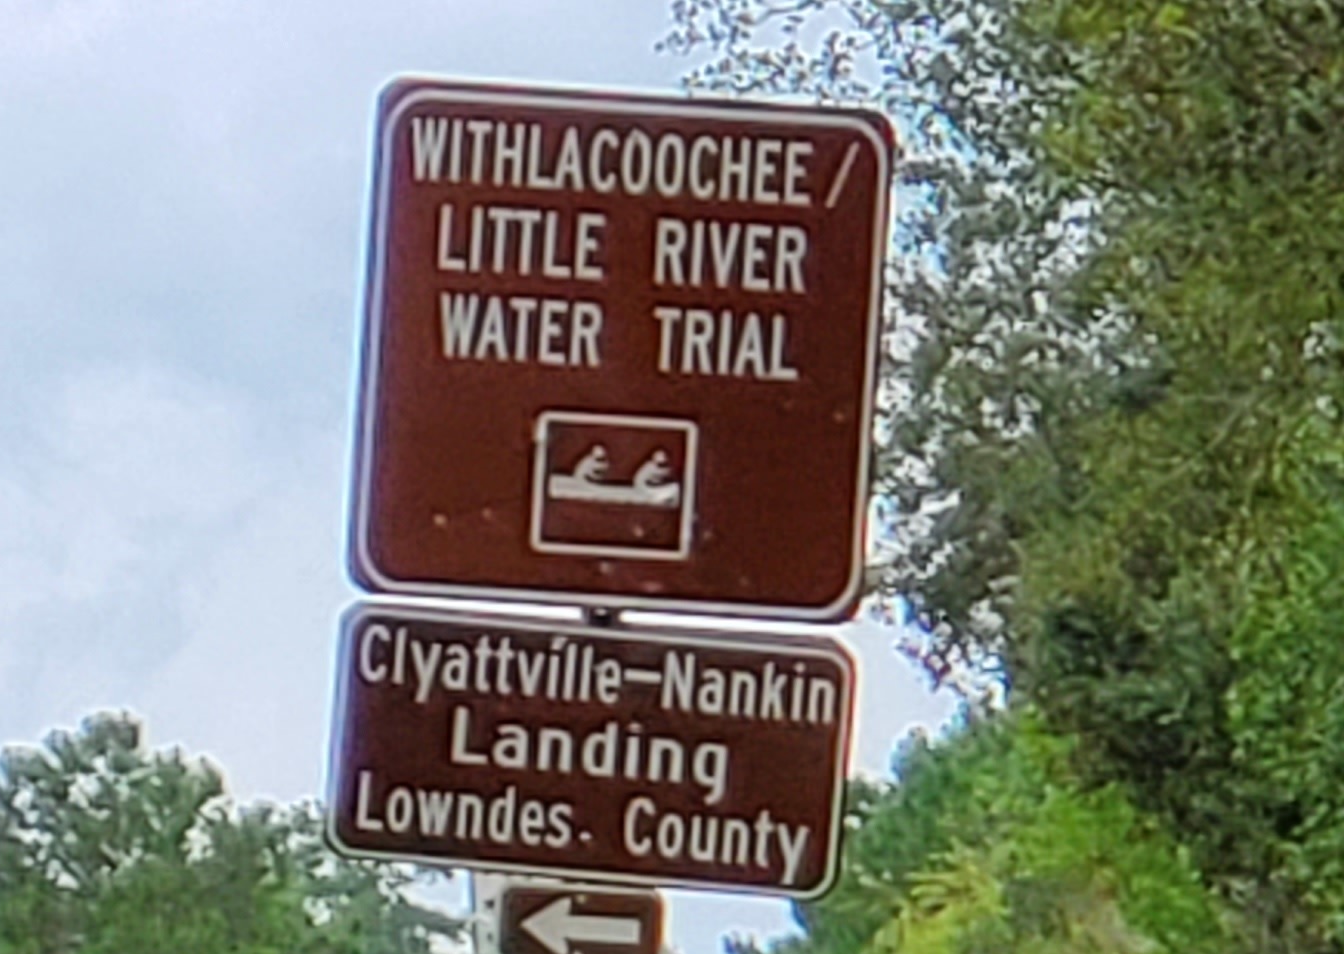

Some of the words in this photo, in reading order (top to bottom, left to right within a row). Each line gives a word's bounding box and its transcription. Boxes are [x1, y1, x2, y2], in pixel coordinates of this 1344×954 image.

[437, 204, 606, 279] LITTLE
[653, 217, 808, 293] RIVER
[439, 292, 603, 367] WATER
[653, 306, 798, 380] TRIAL
[451, 706, 728, 804] Landing
[623, 797, 810, 884] County
